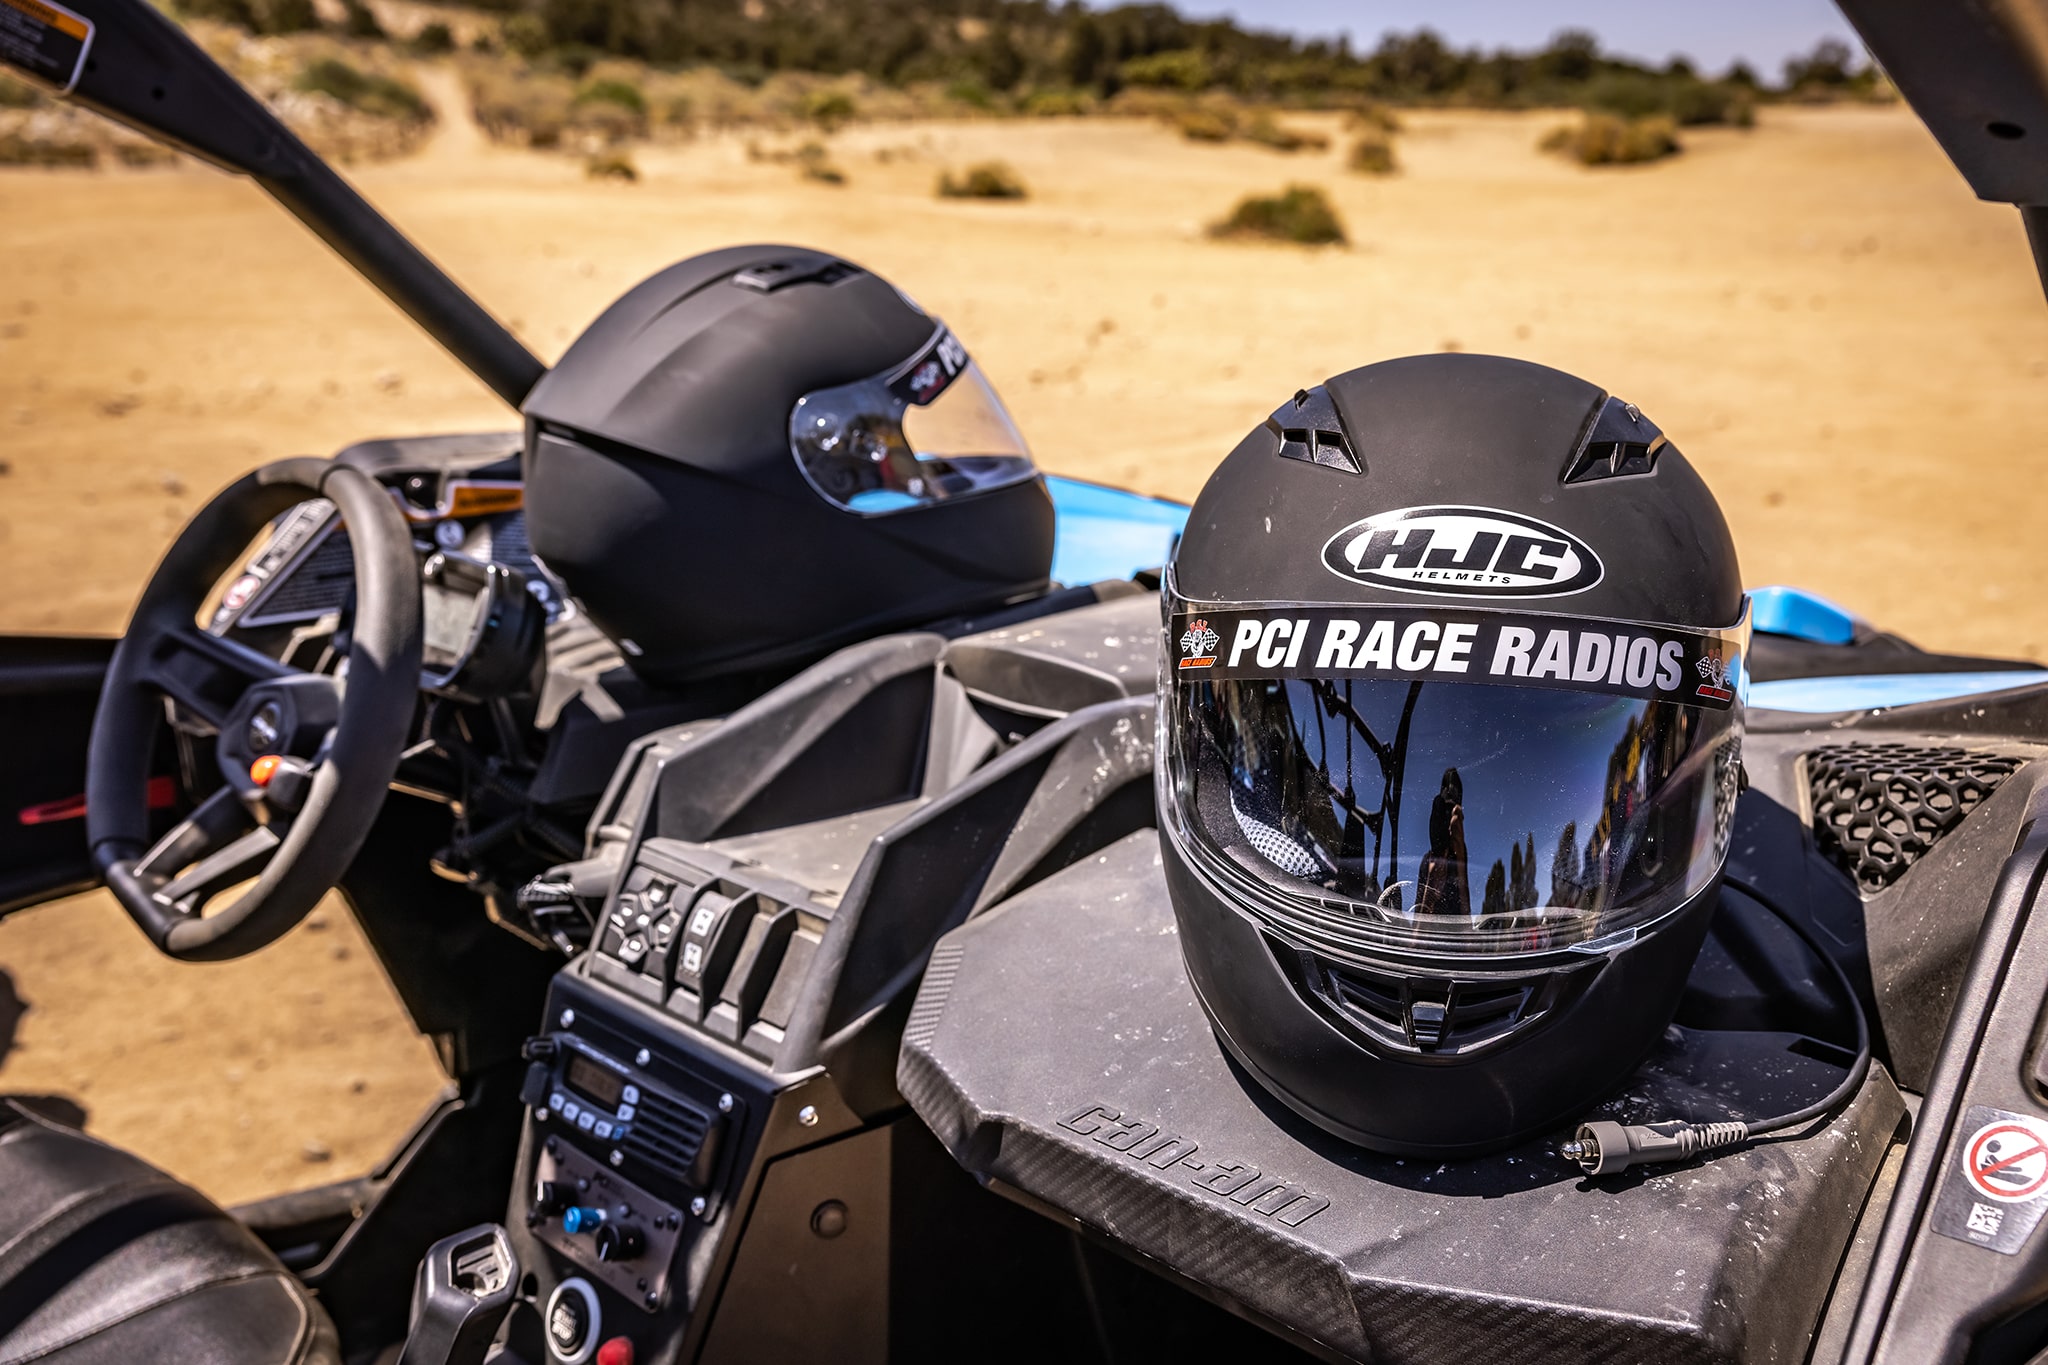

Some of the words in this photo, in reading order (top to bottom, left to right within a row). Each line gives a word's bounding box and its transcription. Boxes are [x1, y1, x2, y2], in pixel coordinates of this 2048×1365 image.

[1357, 529, 1570, 580] HJC
[1412, 570, 1512, 584] HELMETS
[1227, 619, 1310, 668] PCI
[1315, 619, 1478, 673] RACE
[1490, 626, 1684, 690] RADIOS
[1056, 1101, 1331, 1228] can-am
